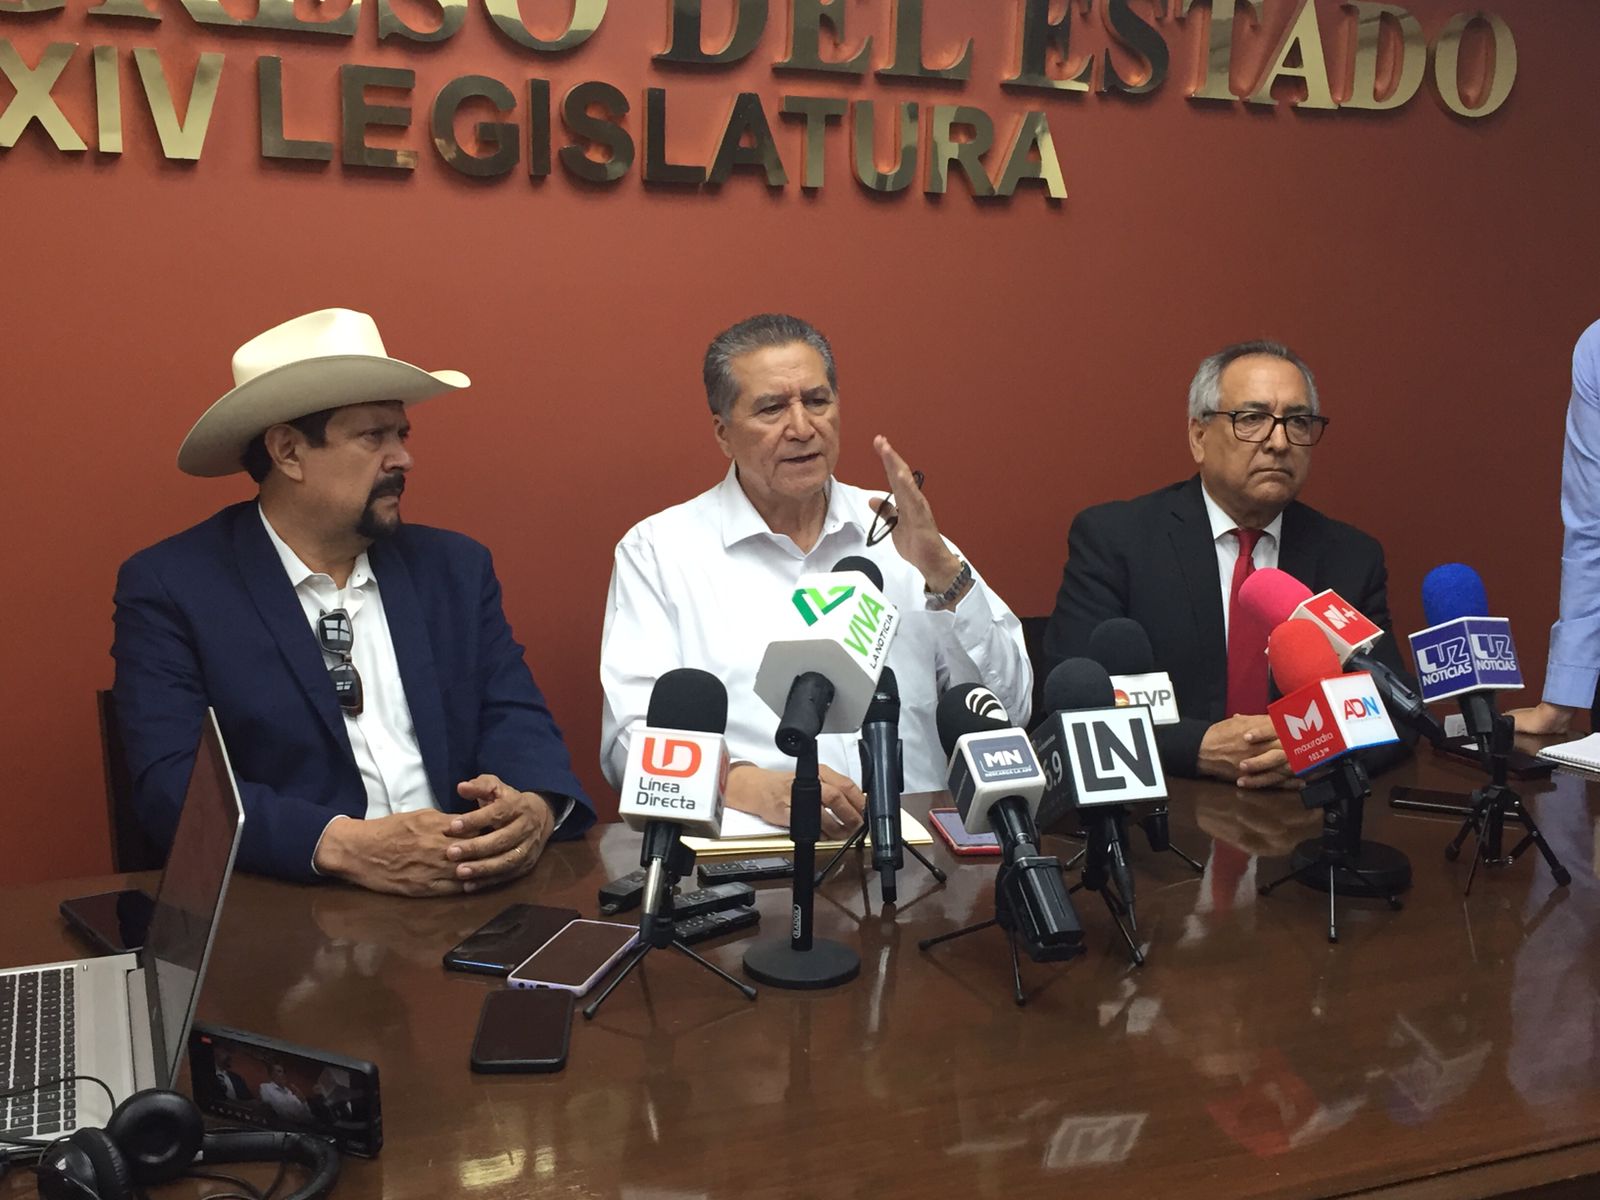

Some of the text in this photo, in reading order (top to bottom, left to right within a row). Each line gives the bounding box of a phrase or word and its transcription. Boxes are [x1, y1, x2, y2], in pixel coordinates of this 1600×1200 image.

[1001, 0, 1517, 118] ESTADO
[258, 55, 1068, 199] LEGISLATURA
[844, 593, 885, 657] VIVA
[869, 614, 894, 669] LA NOTICIA
[1422, 662, 1473, 686] NOTICIAS
[1475, 660, 1517, 671] NOTICIAS
[1129, 690, 1171, 707] TVP
[1344, 696, 1380, 720] ADN
[983, 749, 1023, 767] MN
[1072, 717, 1157, 792] LN
[639, 777, 680, 793] Línea
[636, 791, 696, 810] Directa
